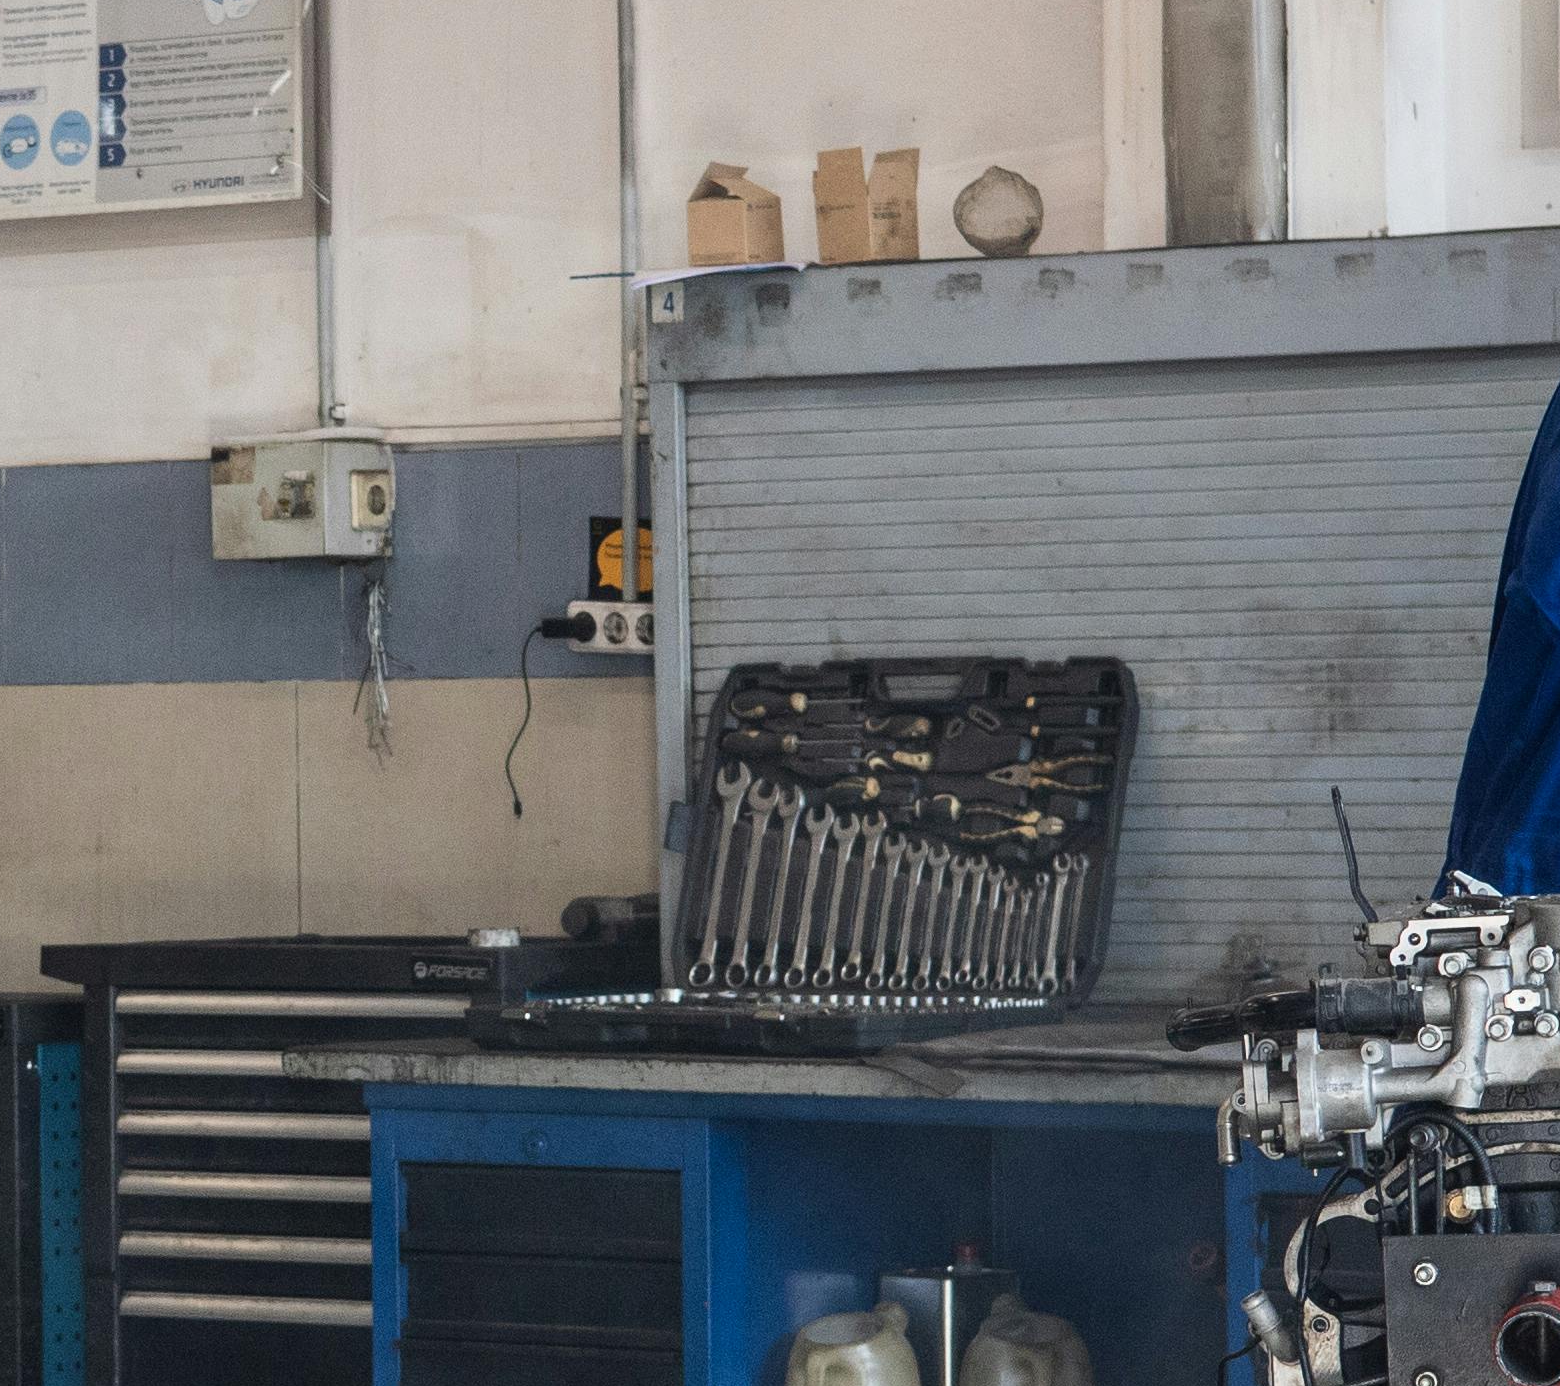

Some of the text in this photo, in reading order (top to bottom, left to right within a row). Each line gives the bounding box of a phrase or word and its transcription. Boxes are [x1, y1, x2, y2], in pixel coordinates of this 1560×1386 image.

[107, 74, 116, 88] 2
[107, 148, 116, 162] 5
[193, 175, 245, 191] HYUNDAI
[663, 291, 675, 314] 4
